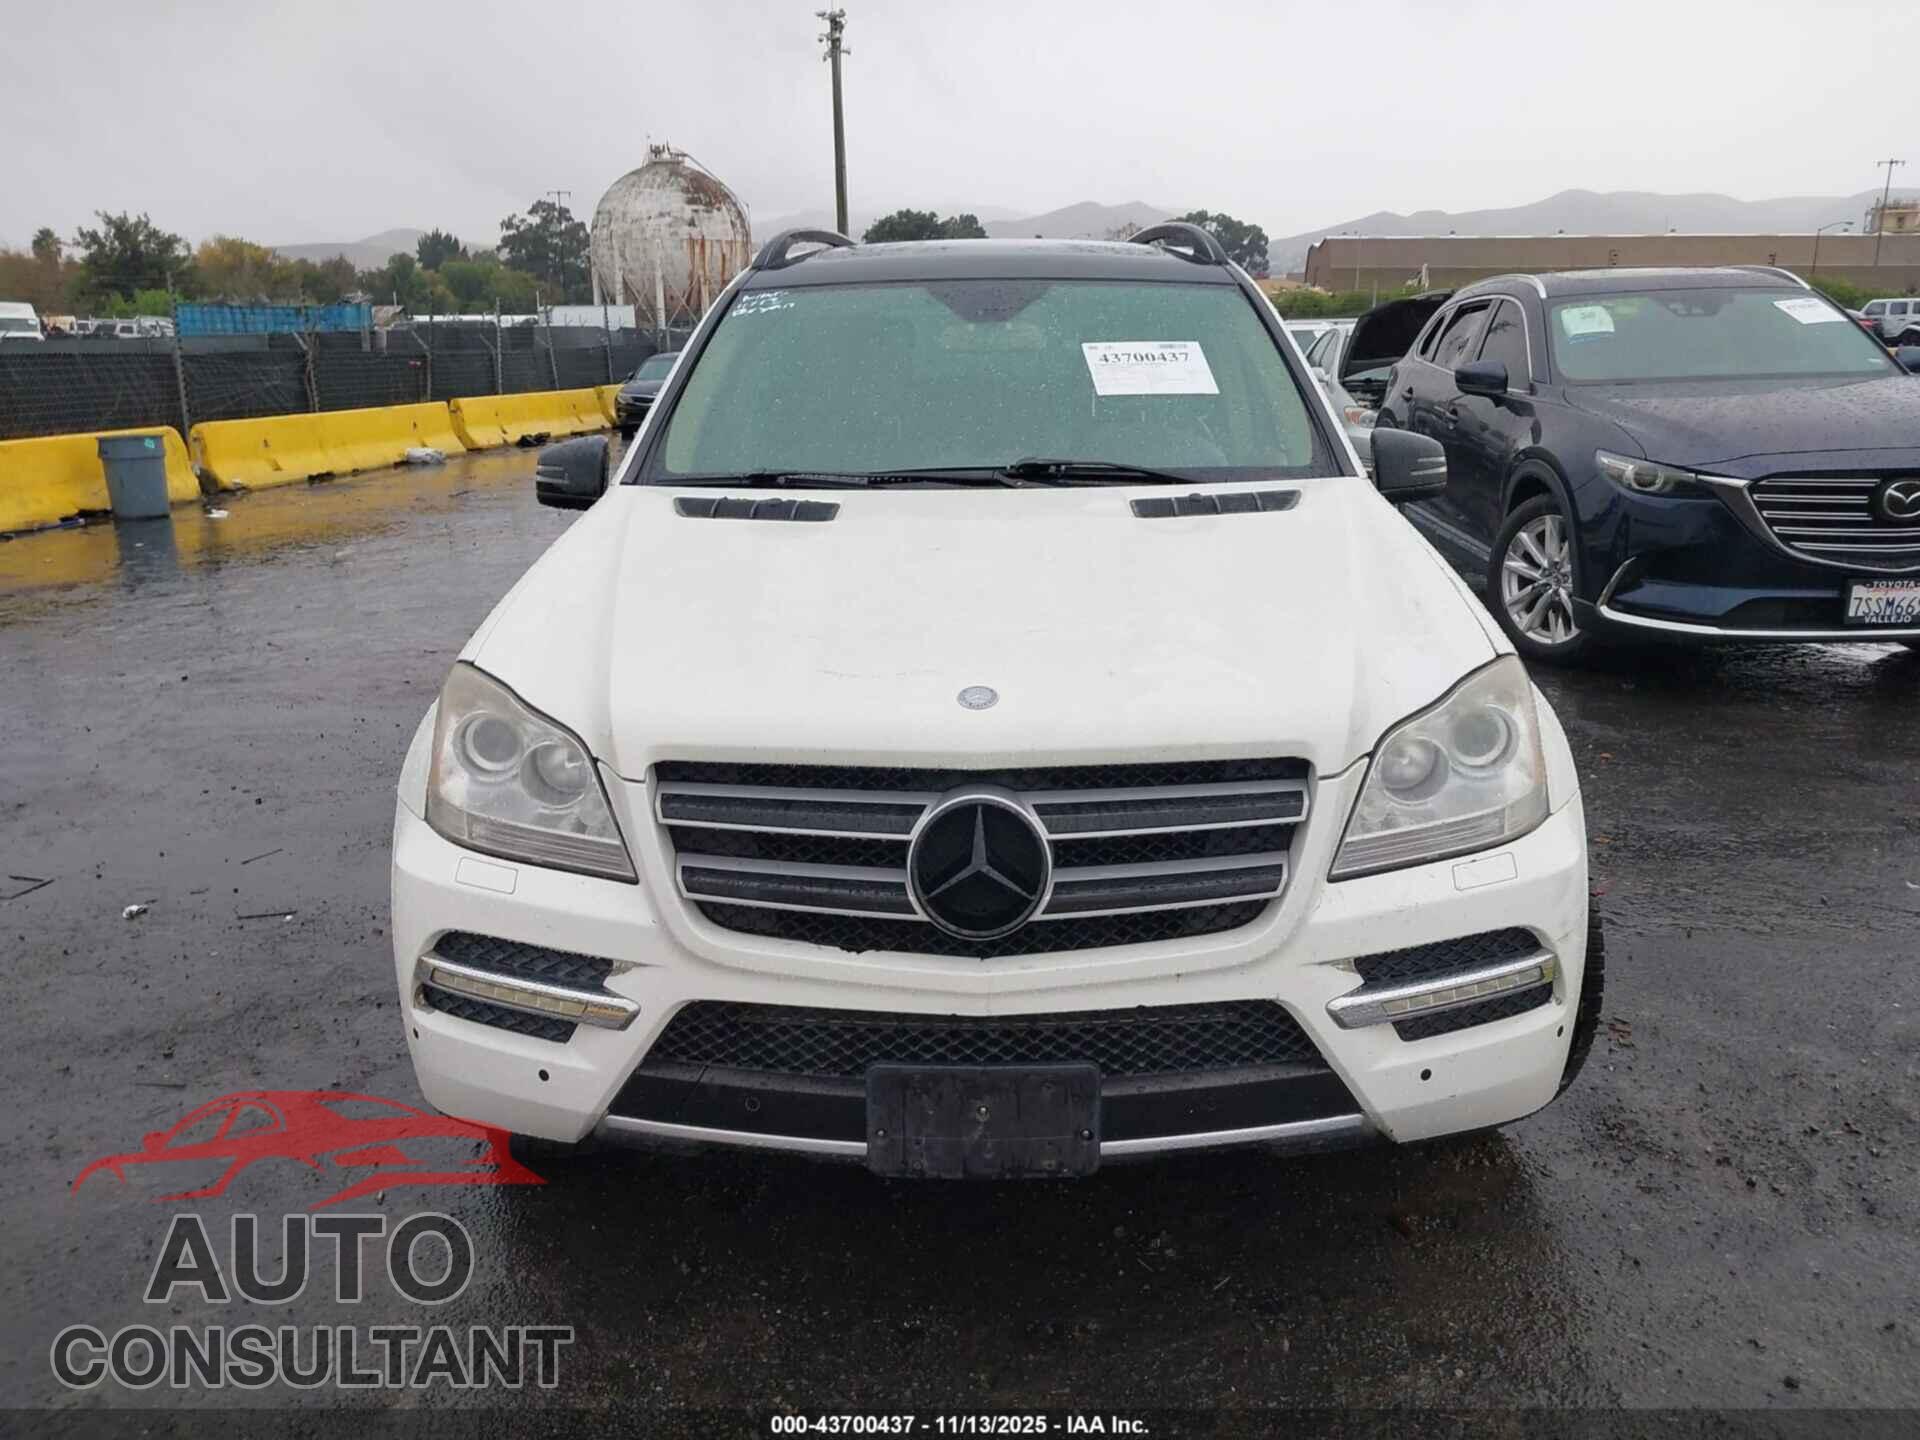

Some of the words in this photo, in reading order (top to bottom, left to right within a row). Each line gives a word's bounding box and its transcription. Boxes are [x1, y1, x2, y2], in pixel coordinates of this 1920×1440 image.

[1099, 352, 1189, 363] 43700437
[1853, 596, 1920, 616] 7SSM66
[1864, 615, 1912, 623] VALLEJO
